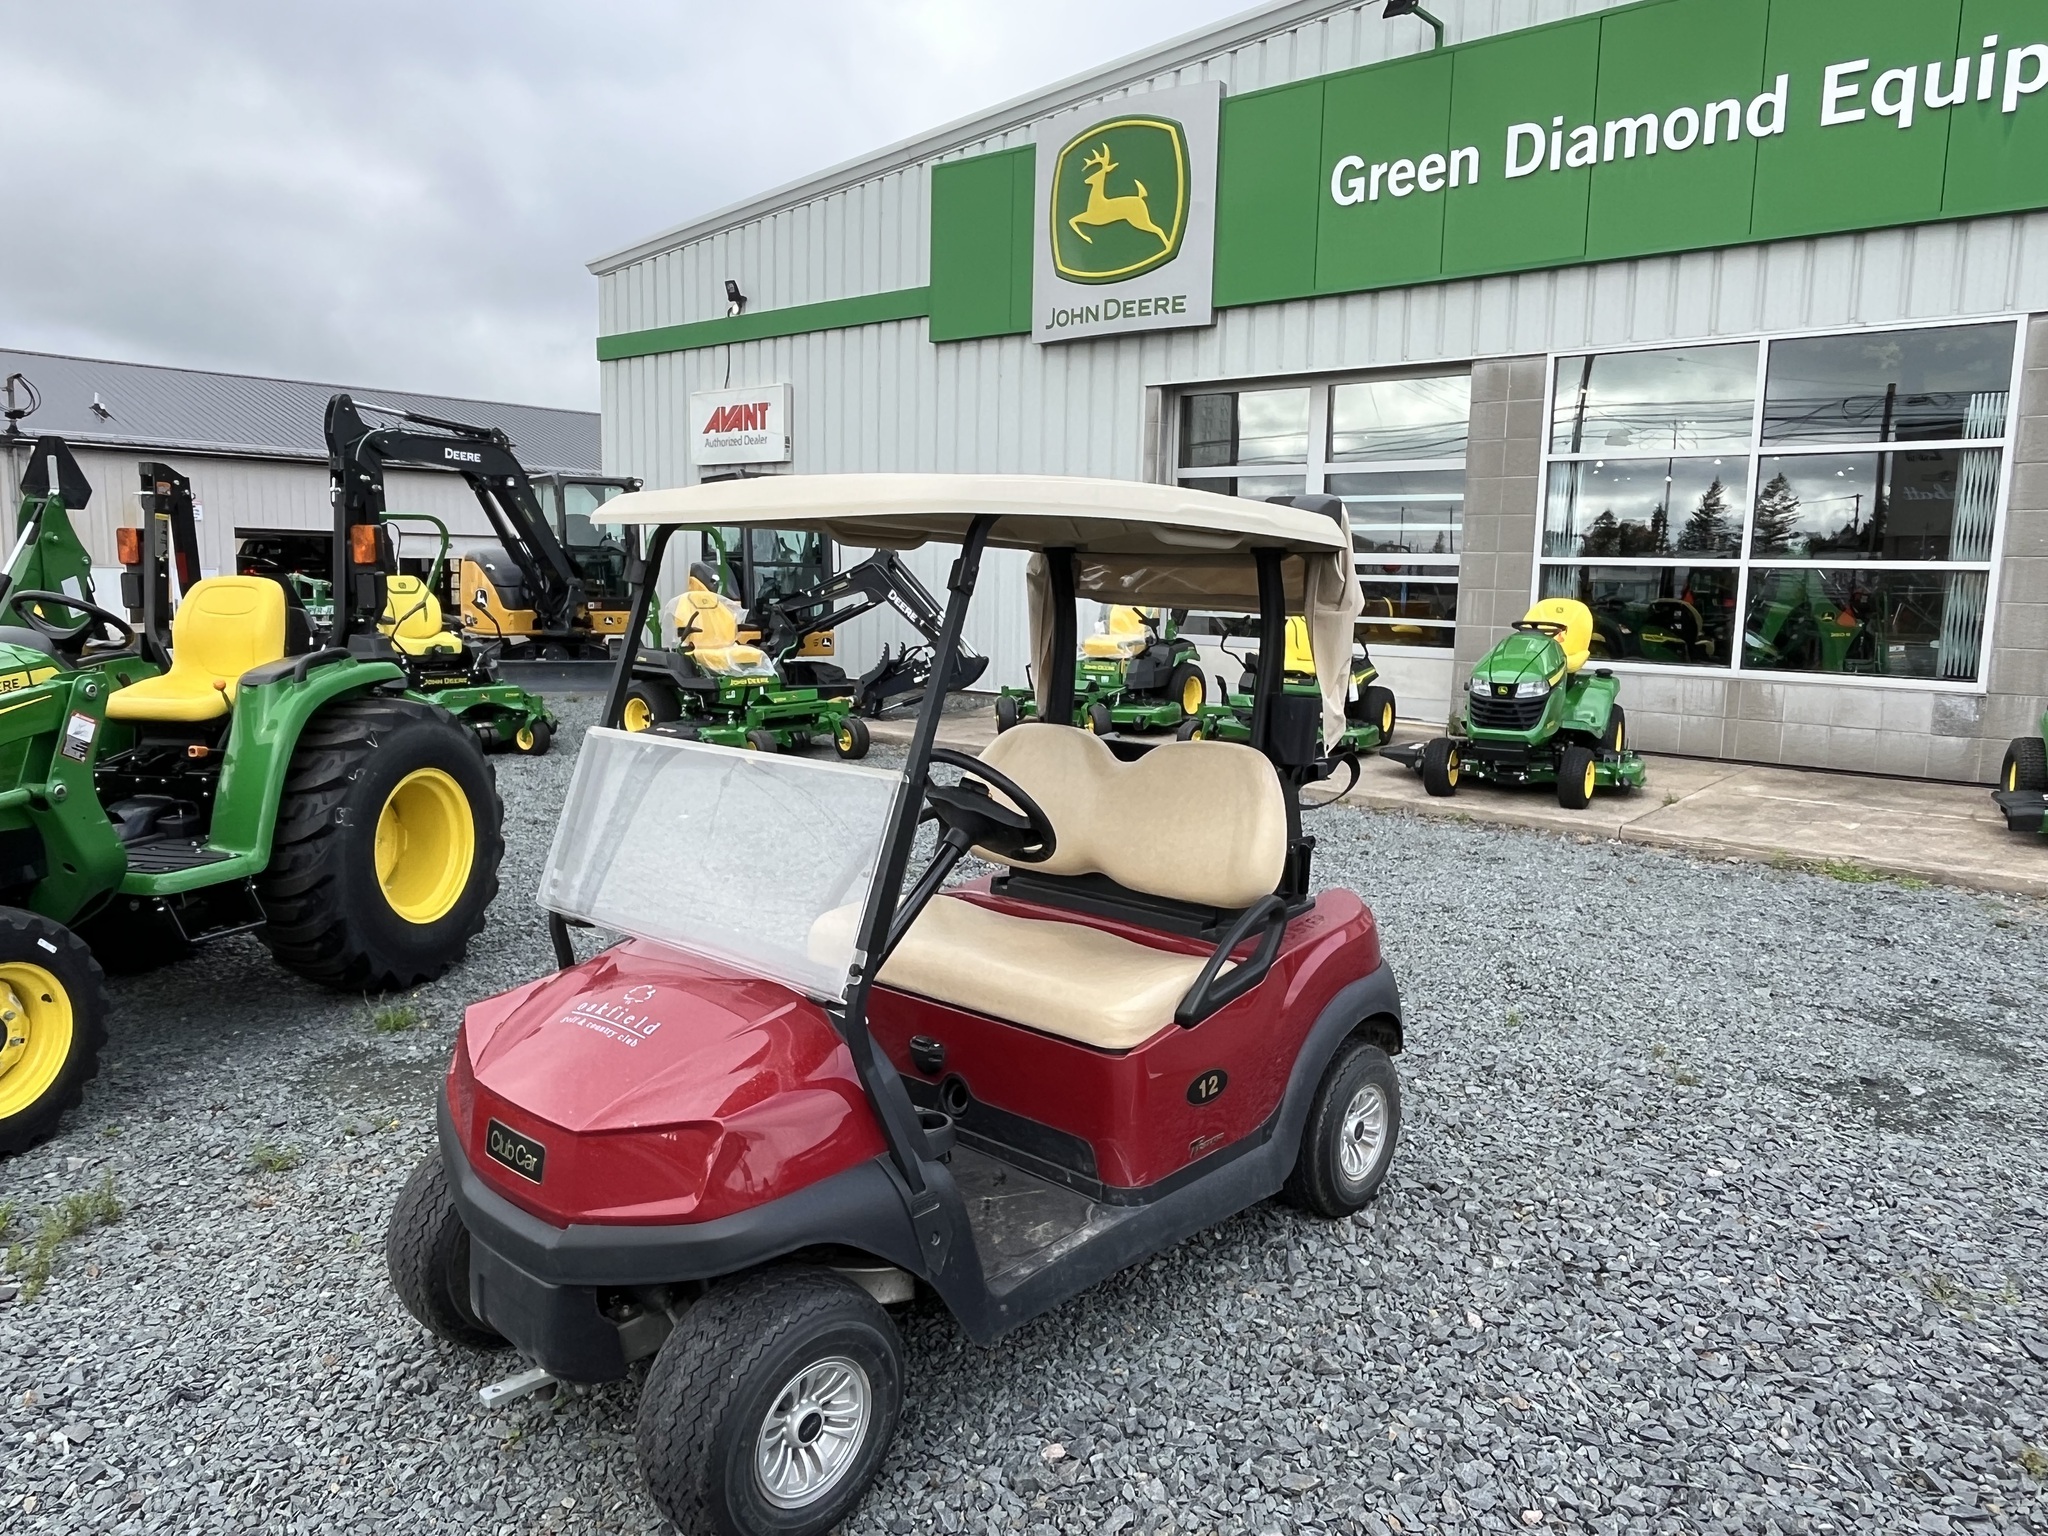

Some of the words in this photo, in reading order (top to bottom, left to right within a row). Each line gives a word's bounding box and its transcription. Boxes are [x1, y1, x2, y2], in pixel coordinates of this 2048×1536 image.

[1330, 145, 1479, 207] Green
[1505, 74, 1788, 180] Diamond
[1820, 34, 2048, 129] Equip
[1045, 304, 1100, 330] JOHN
[1103, 295, 1187, 321] DEERE
[703, 402, 769, 434] AVANT
[444, 447, 482, 463] DEERE
[704, 435, 743, 448] Authorized
[744, 434, 768, 446] Dealer
[887, 589, 919, 623] DEERE
[576, 1002, 662, 1036] oakfield
[586, 1021, 618, 1039] country
[617, 1034, 639, 1048] club
[1198, 1075, 1219, 1098] 12
[491, 1129, 515, 1161] Club
[515, 1144, 538, 1172] Car
